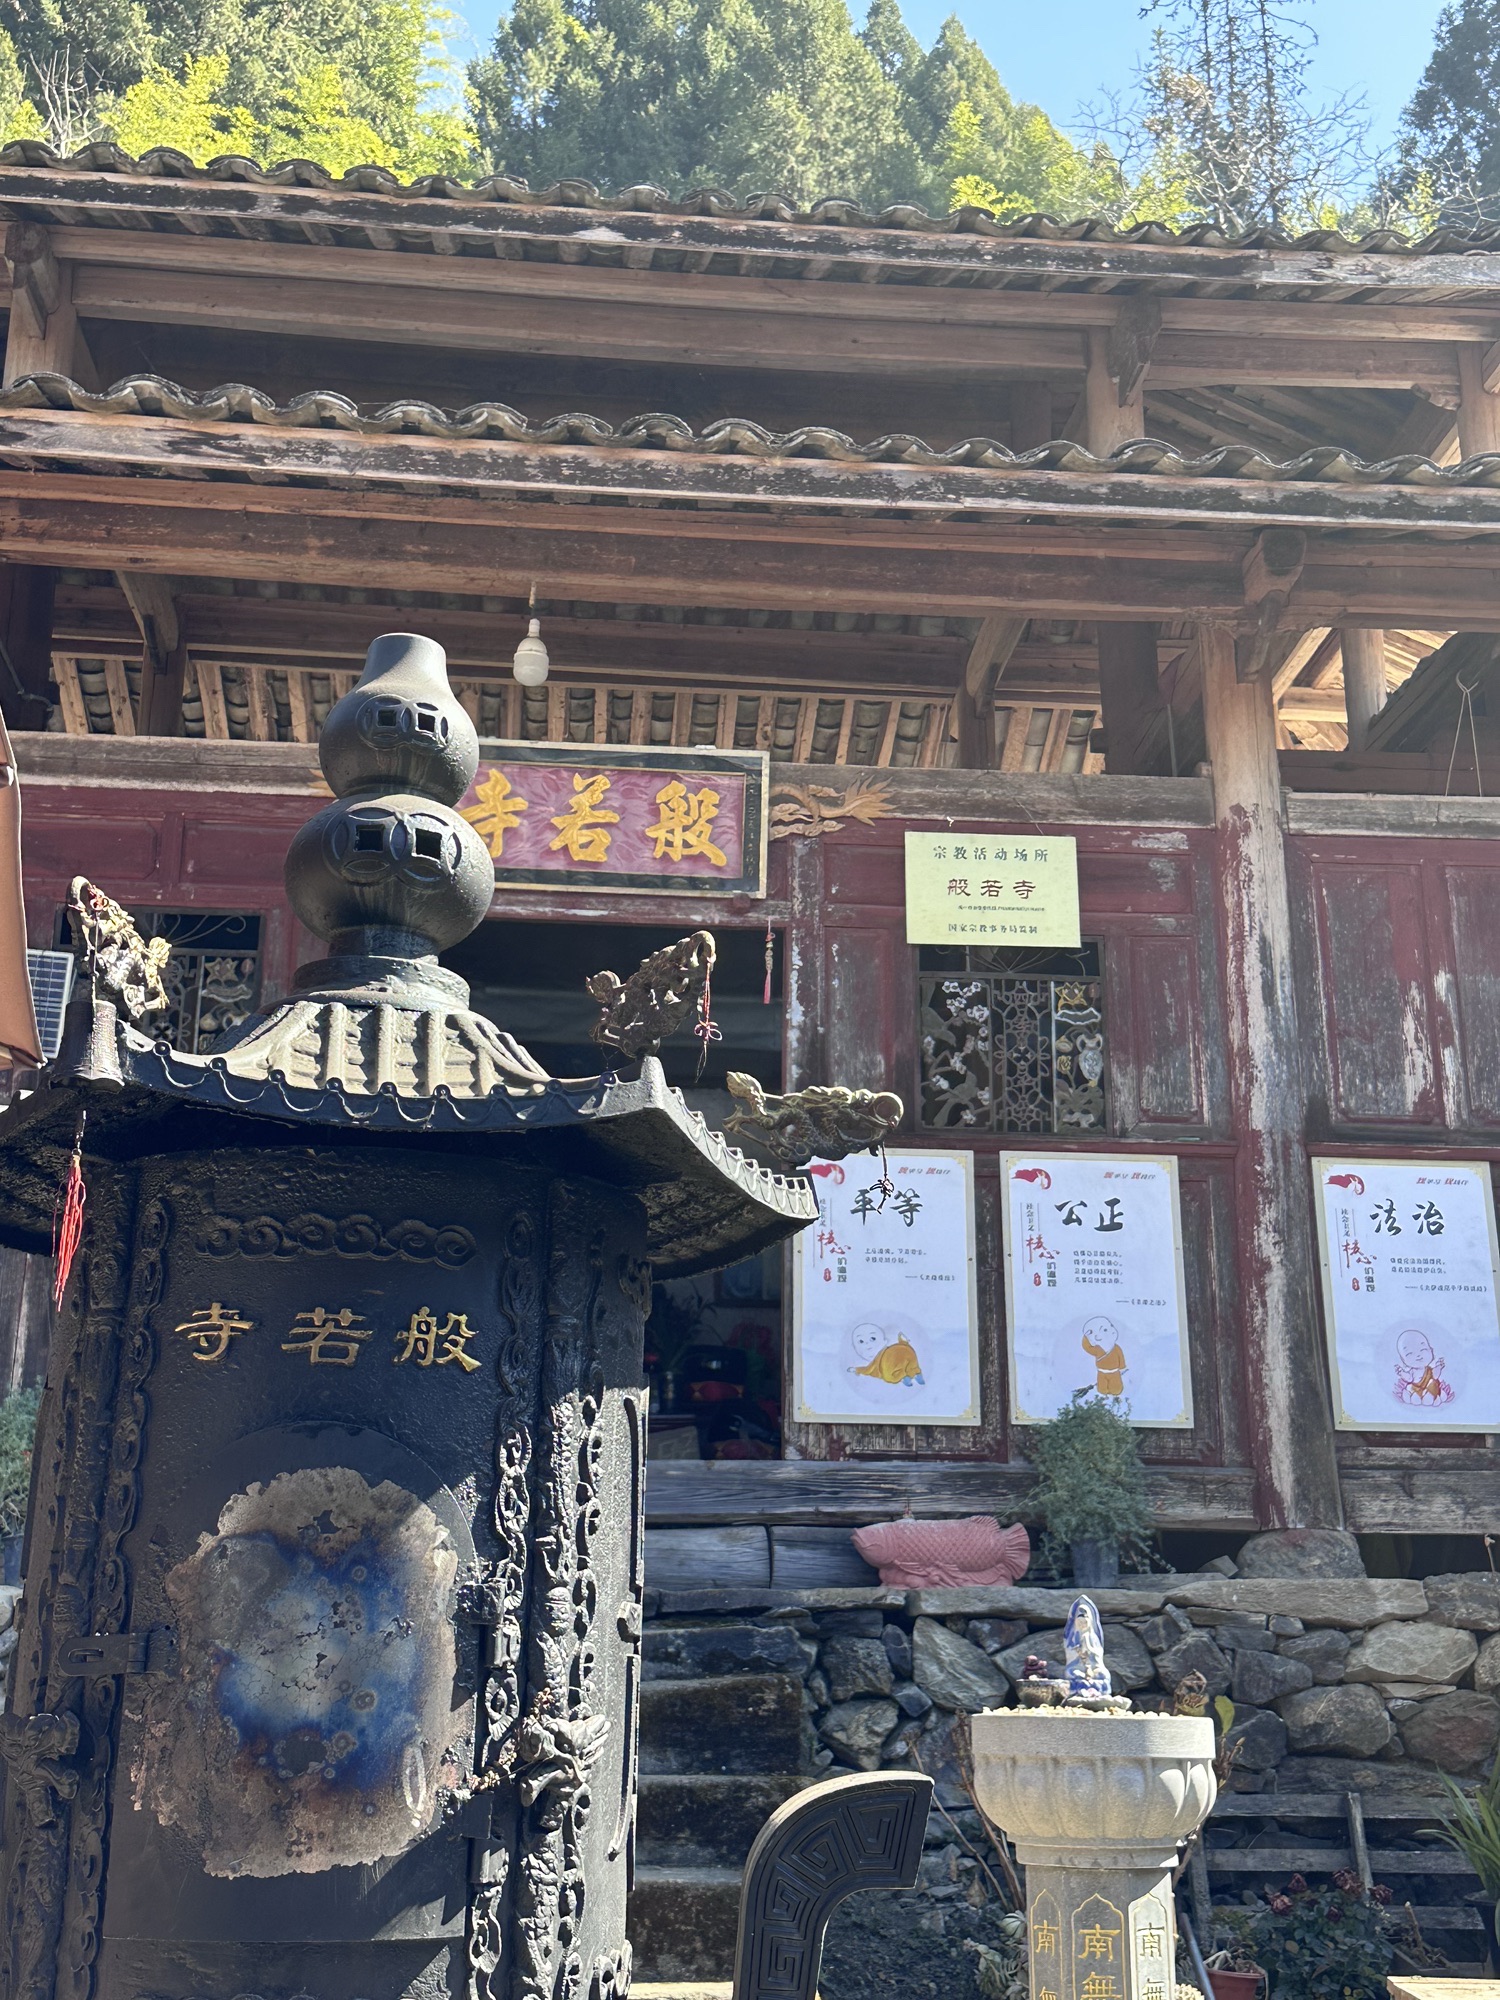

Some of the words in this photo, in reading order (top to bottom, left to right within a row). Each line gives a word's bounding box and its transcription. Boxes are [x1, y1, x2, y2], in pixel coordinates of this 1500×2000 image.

[932, 845, 1049, 863] 宗教活动场所
[947, 878, 1036, 900] 般若寺
[850, 1188, 923, 1227] 平等
[1054, 1197, 1124, 1232] 公正
[1369, 1198, 1445, 1236] 法治
[174, 1302, 483, 1372] 般若寺
